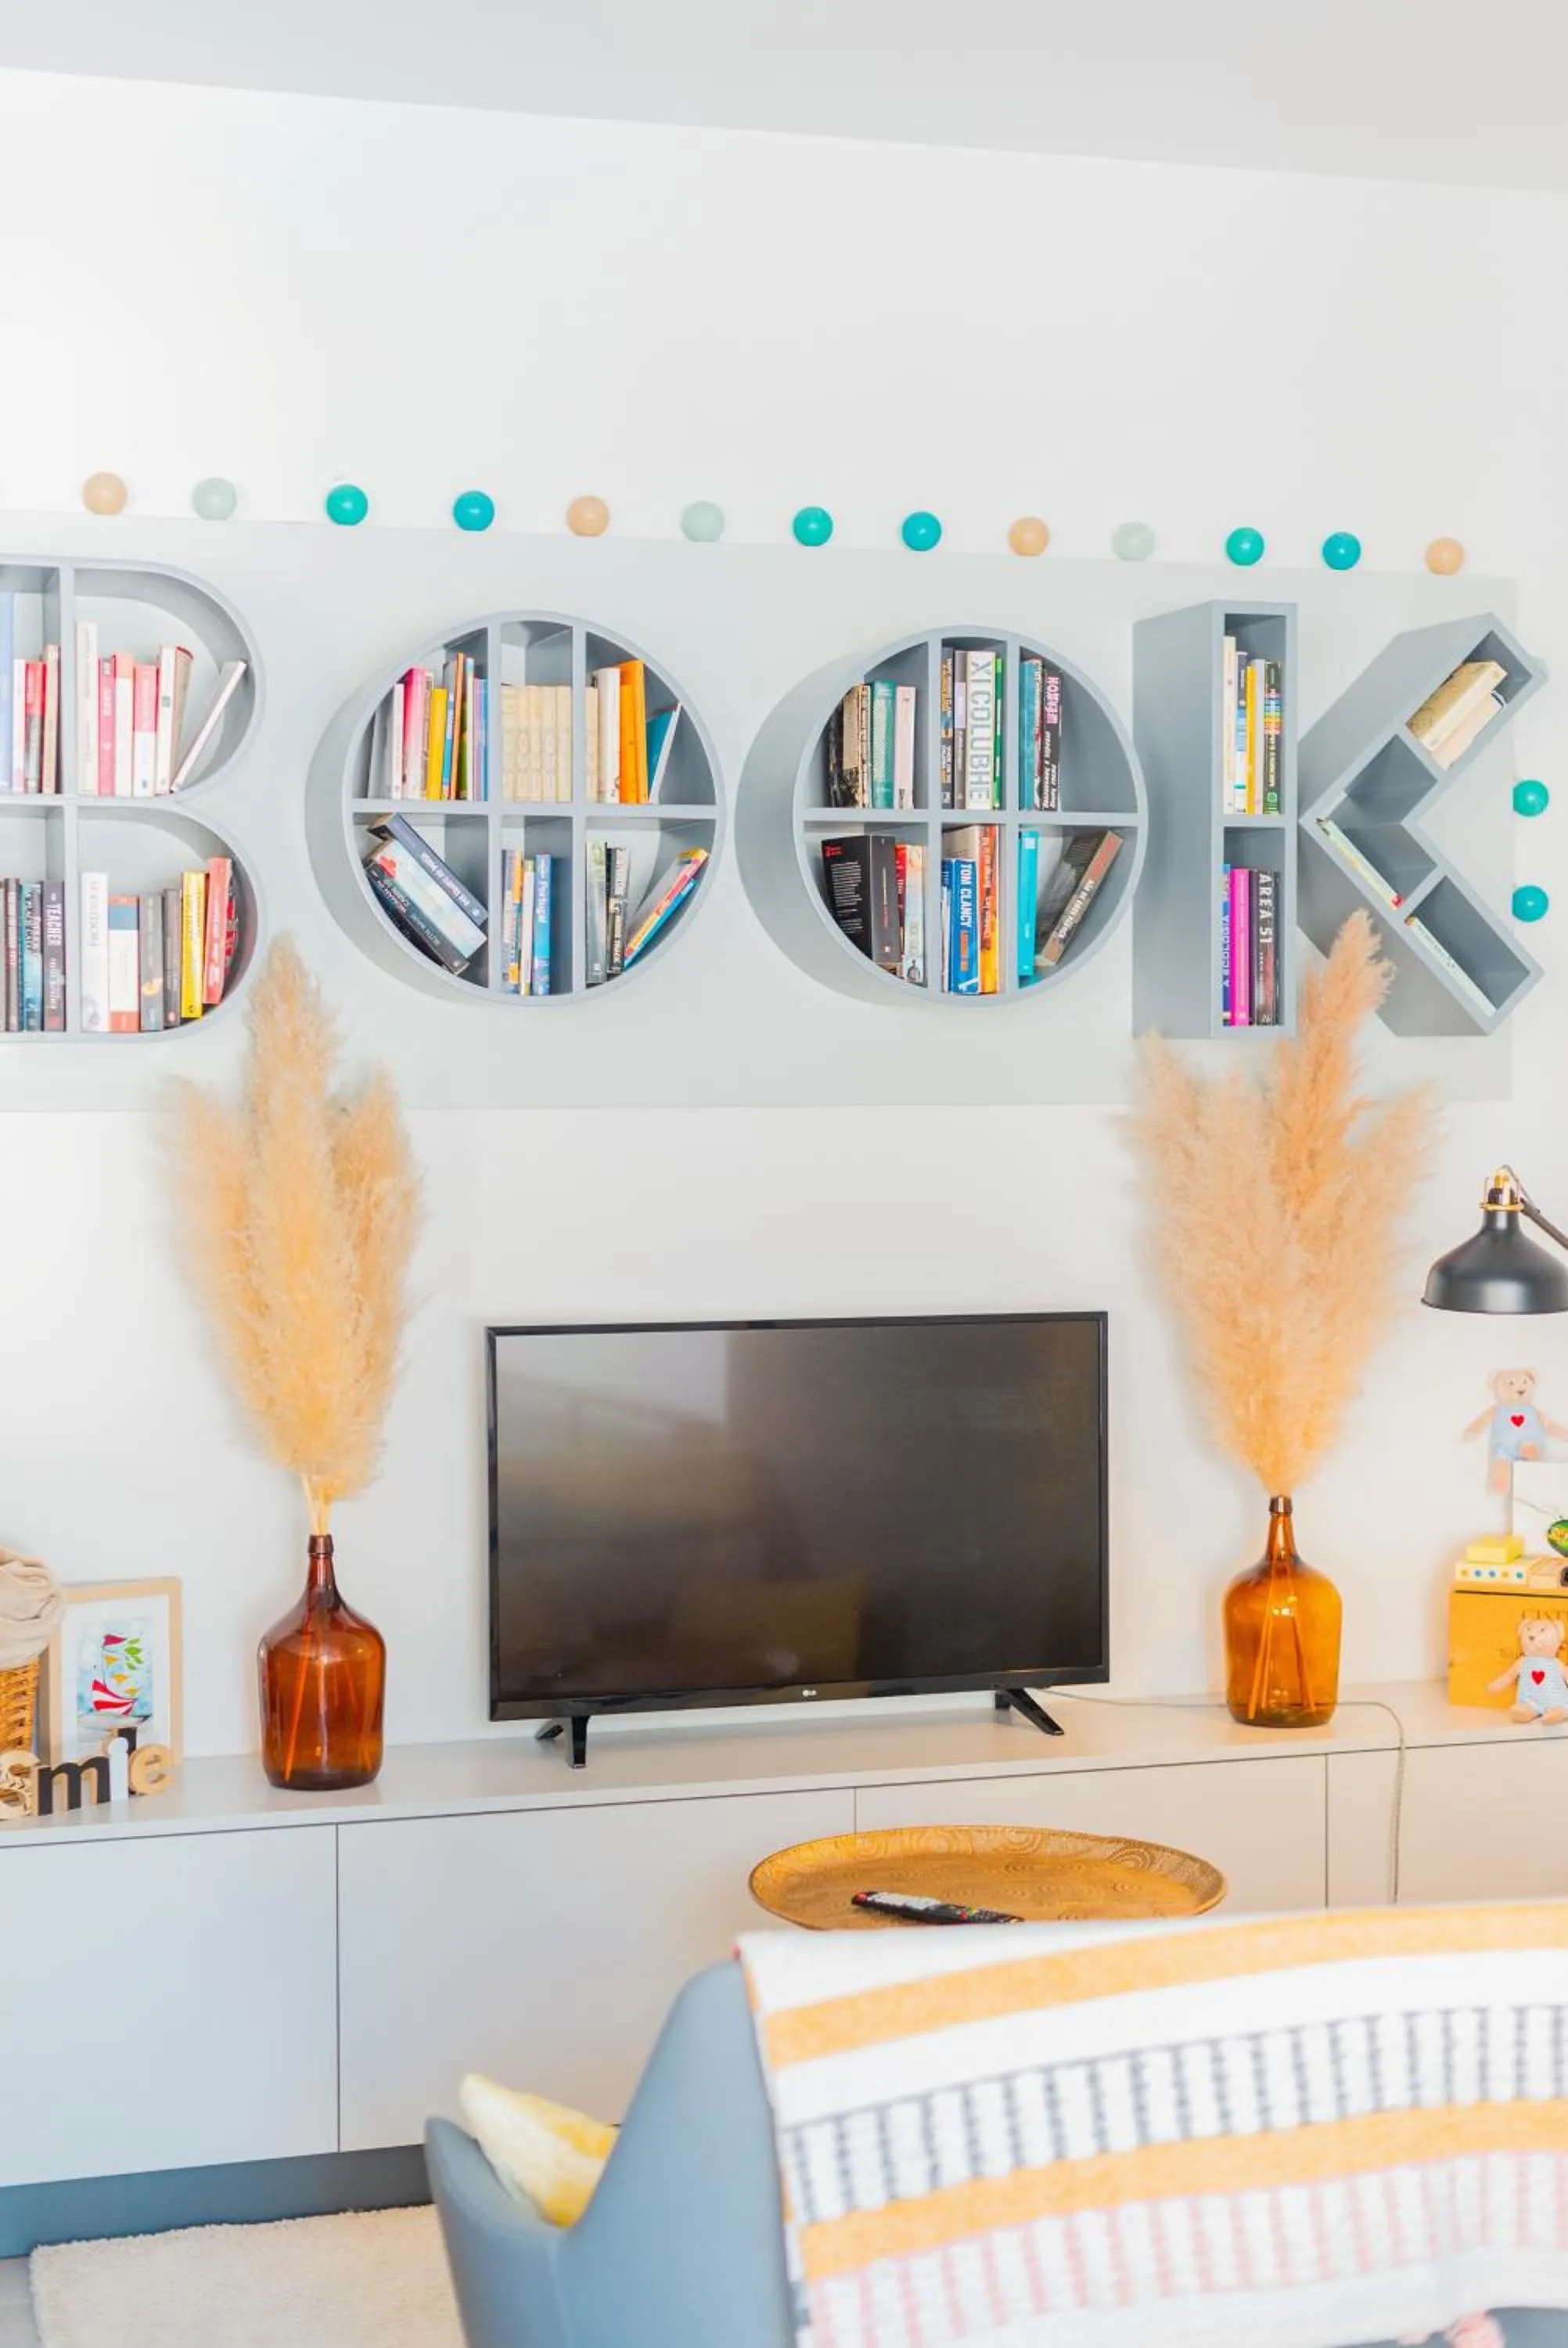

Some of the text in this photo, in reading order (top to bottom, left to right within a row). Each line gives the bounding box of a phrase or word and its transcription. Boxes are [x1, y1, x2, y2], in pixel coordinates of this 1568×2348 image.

[960, 863, 972, 884] TOM
[45, 903, 62, 946] TEACHER
[960, 888, 972, 927] CLANCY
[1259, 873, 1272, 944] AREA 51
